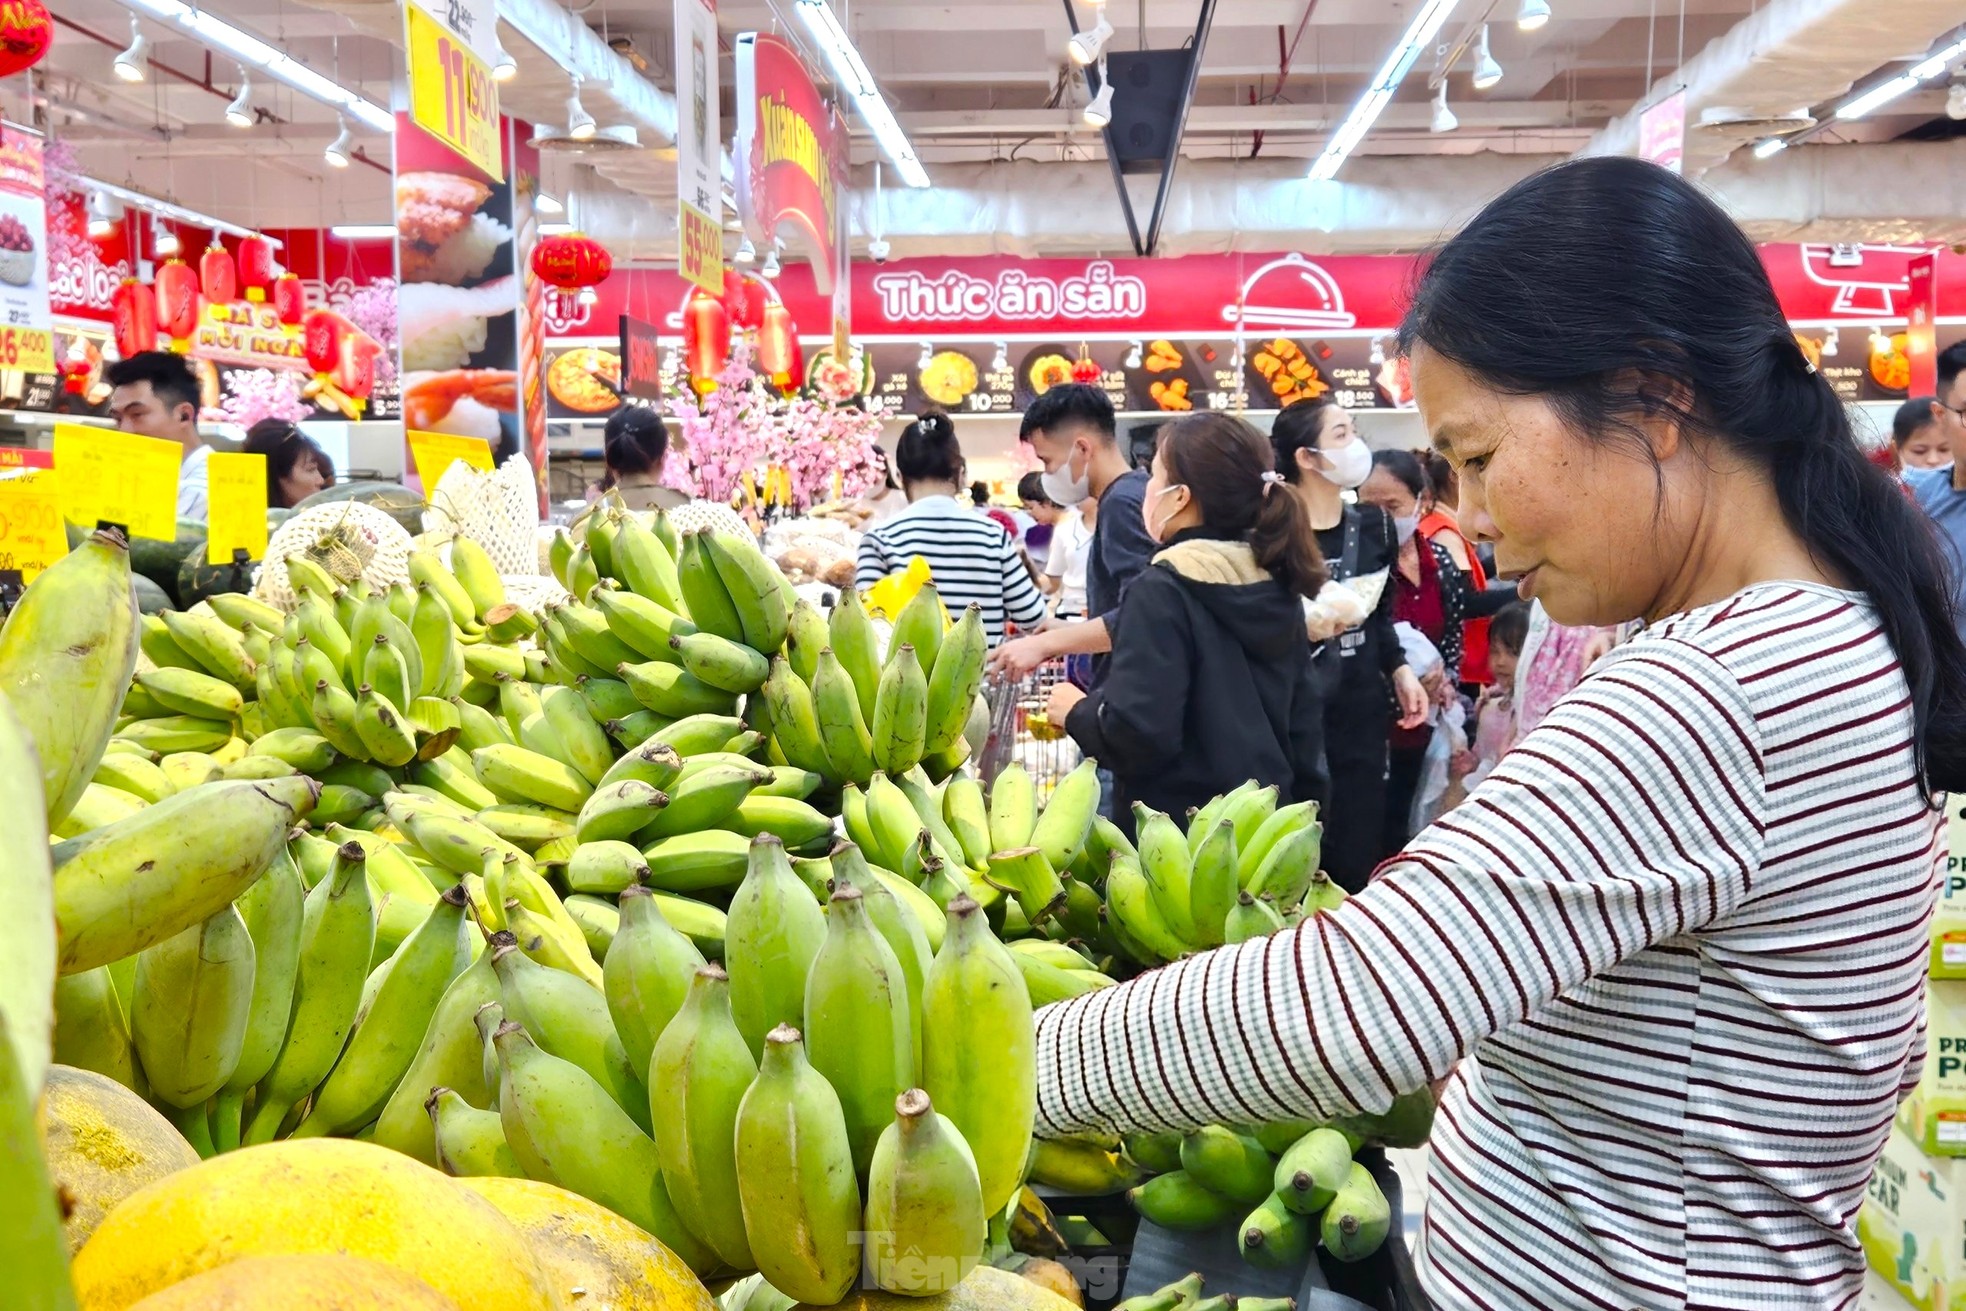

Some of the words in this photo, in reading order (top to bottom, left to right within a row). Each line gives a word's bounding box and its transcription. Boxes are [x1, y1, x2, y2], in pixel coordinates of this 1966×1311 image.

[877, 272, 991, 316] Thức
[999, 272, 1052, 314] ăn
[1064, 267, 1139, 313] sẵn
[251, 336, 306, 358] NGÀ
[1208, 392, 1249, 409] 16.00
